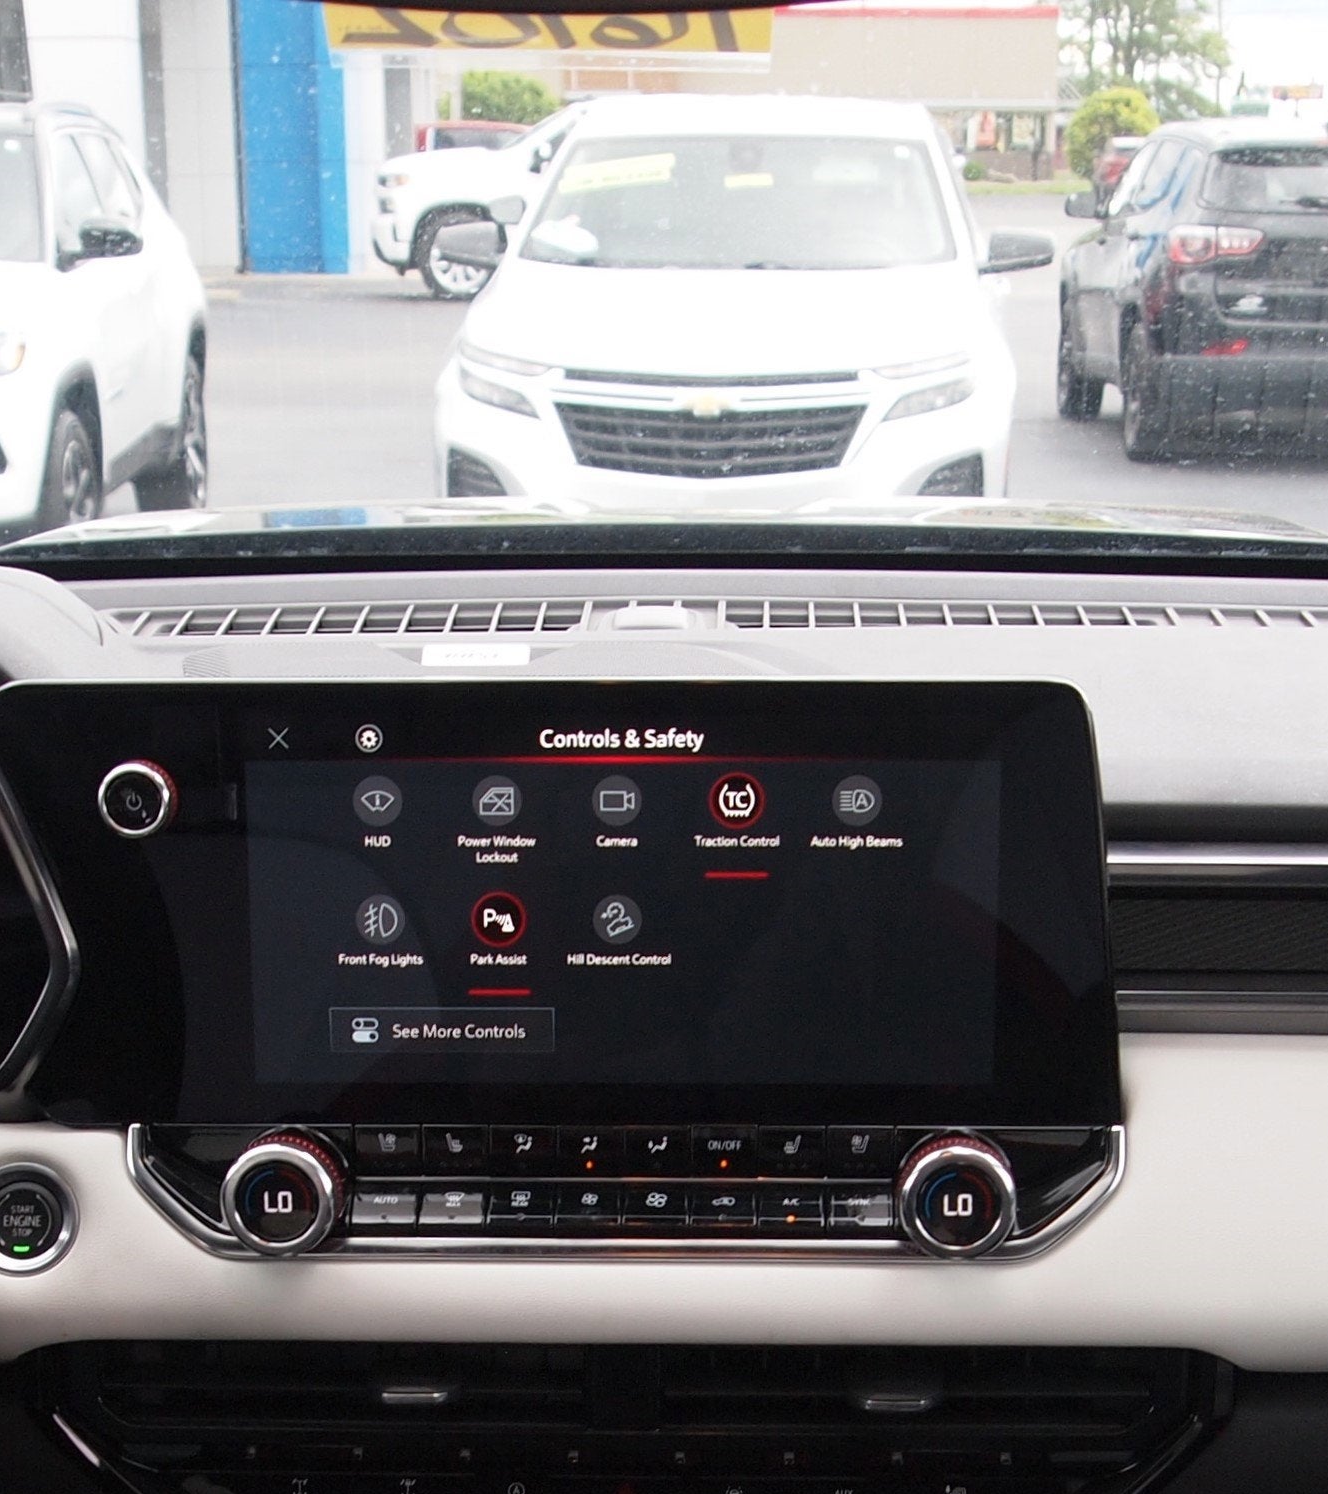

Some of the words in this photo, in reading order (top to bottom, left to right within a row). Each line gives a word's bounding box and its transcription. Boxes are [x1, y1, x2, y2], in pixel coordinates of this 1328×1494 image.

[539, 728, 621, 750] Controls
[624, 728, 641, 750] &
[644, 728, 705, 753] Safety
[364, 835, 392, 848] HUD
[457, 835, 492, 849] Power
[492, 835, 537, 848] Window
[595, 835, 639, 848] Camera
[693, 834, 738, 848] Traction
[739, 834, 781, 848] Control
[810, 835, 838, 848] Auto
[838, 835, 865, 851] High
[865, 835, 904, 848] Beams
[475, 851, 519, 864] Lockout
[338, 953, 368, 967] Front
[368, 953, 390, 968] Fog
[391, 953, 424, 968] Lights
[470, 953, 495, 966] Park
[495, 953, 528, 966] Assist
[566, 953, 585, 966] Hill
[586, 953, 631, 966] Descent
[631, 953, 672, 966] Control
[392, 1023, 421, 1039] See
[422, 1023, 462, 1039] More
[464, 1022, 526, 1039] Controls
[707, 1138, 743, 1152] ON/OFF
[263, 1190, 294, 1214] LO
[373, 1195, 399, 1205] AUTO
[781, 1197, 801, 1207] A/C
[942, 1193, 973, 1217] LO
[10, 1204, 35, 1214] START
[2, 1214, 42, 1228] ENGINE
[11, 1228, 33, 1237] STOP
